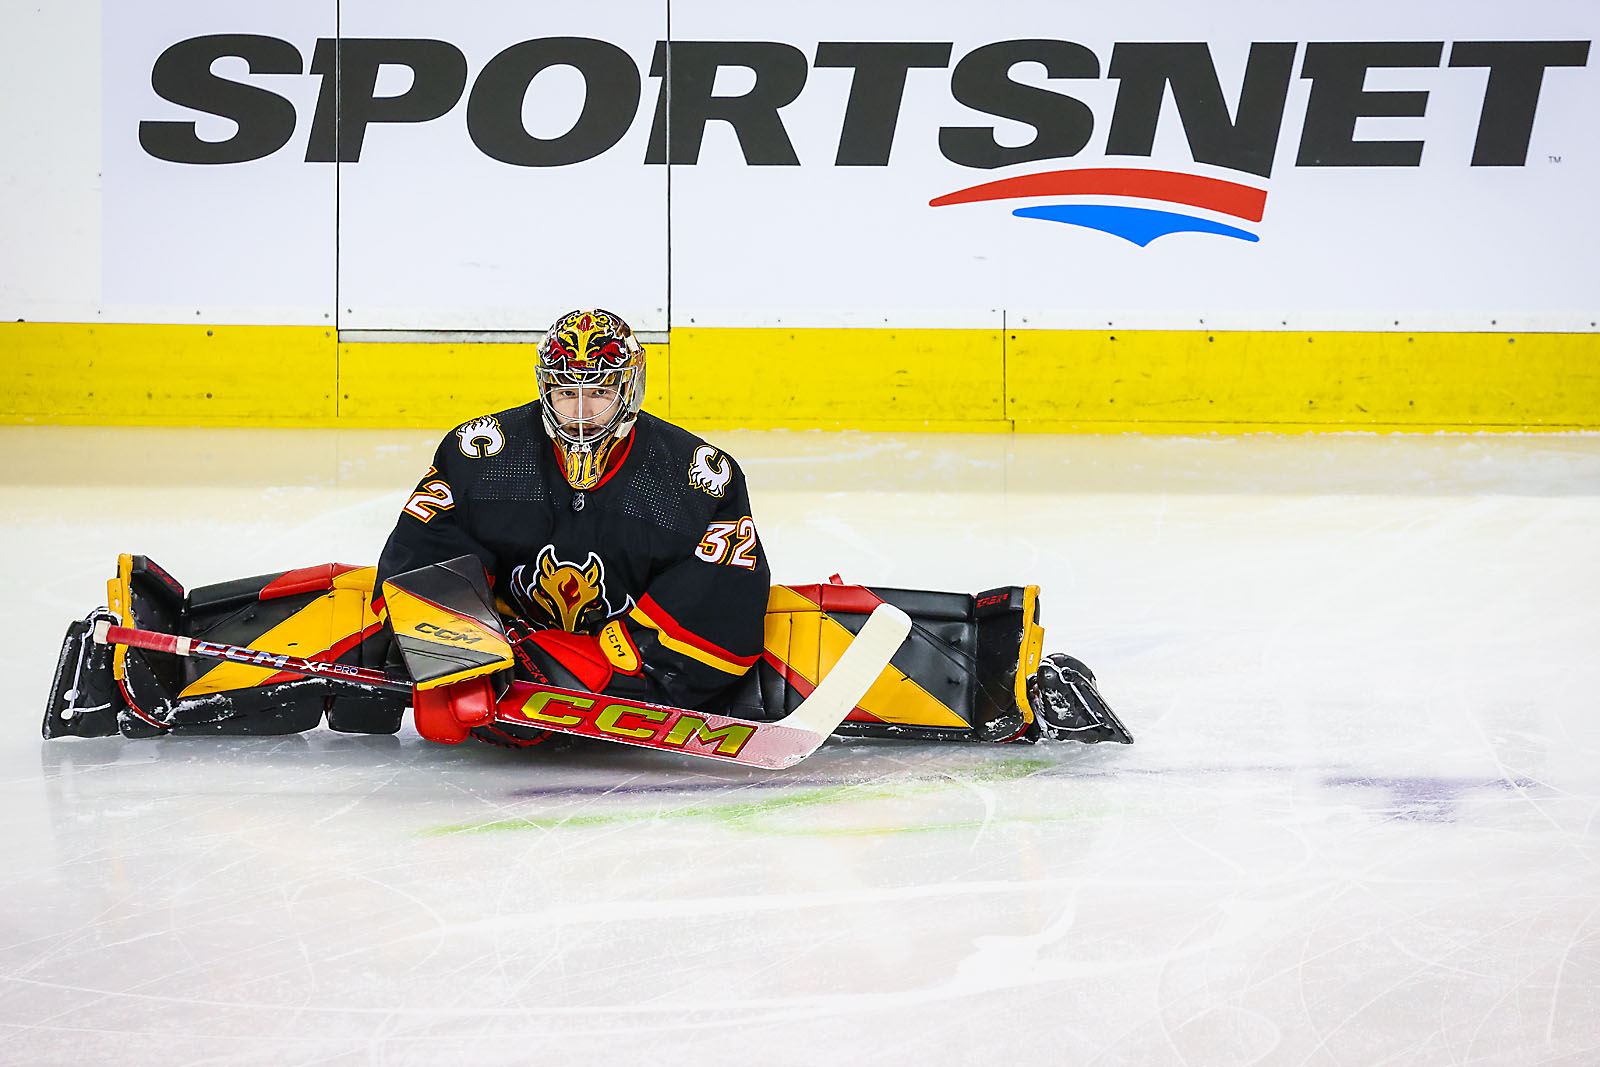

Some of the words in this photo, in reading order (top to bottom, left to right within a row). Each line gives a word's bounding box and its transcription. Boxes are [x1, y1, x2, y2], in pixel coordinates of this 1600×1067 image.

[138, 35, 1591, 179] SPORTSNET
[402, 466, 456, 524] 2
[694, 516, 757, 571] 32
[195, 641, 290, 668] CCM
[301, 659, 333, 672] XF
[334, 664, 360, 676] PRO
[414, 622, 483, 645] CCM
[605, 626, 626, 658] CCM
[520, 691, 758, 758] CCM
